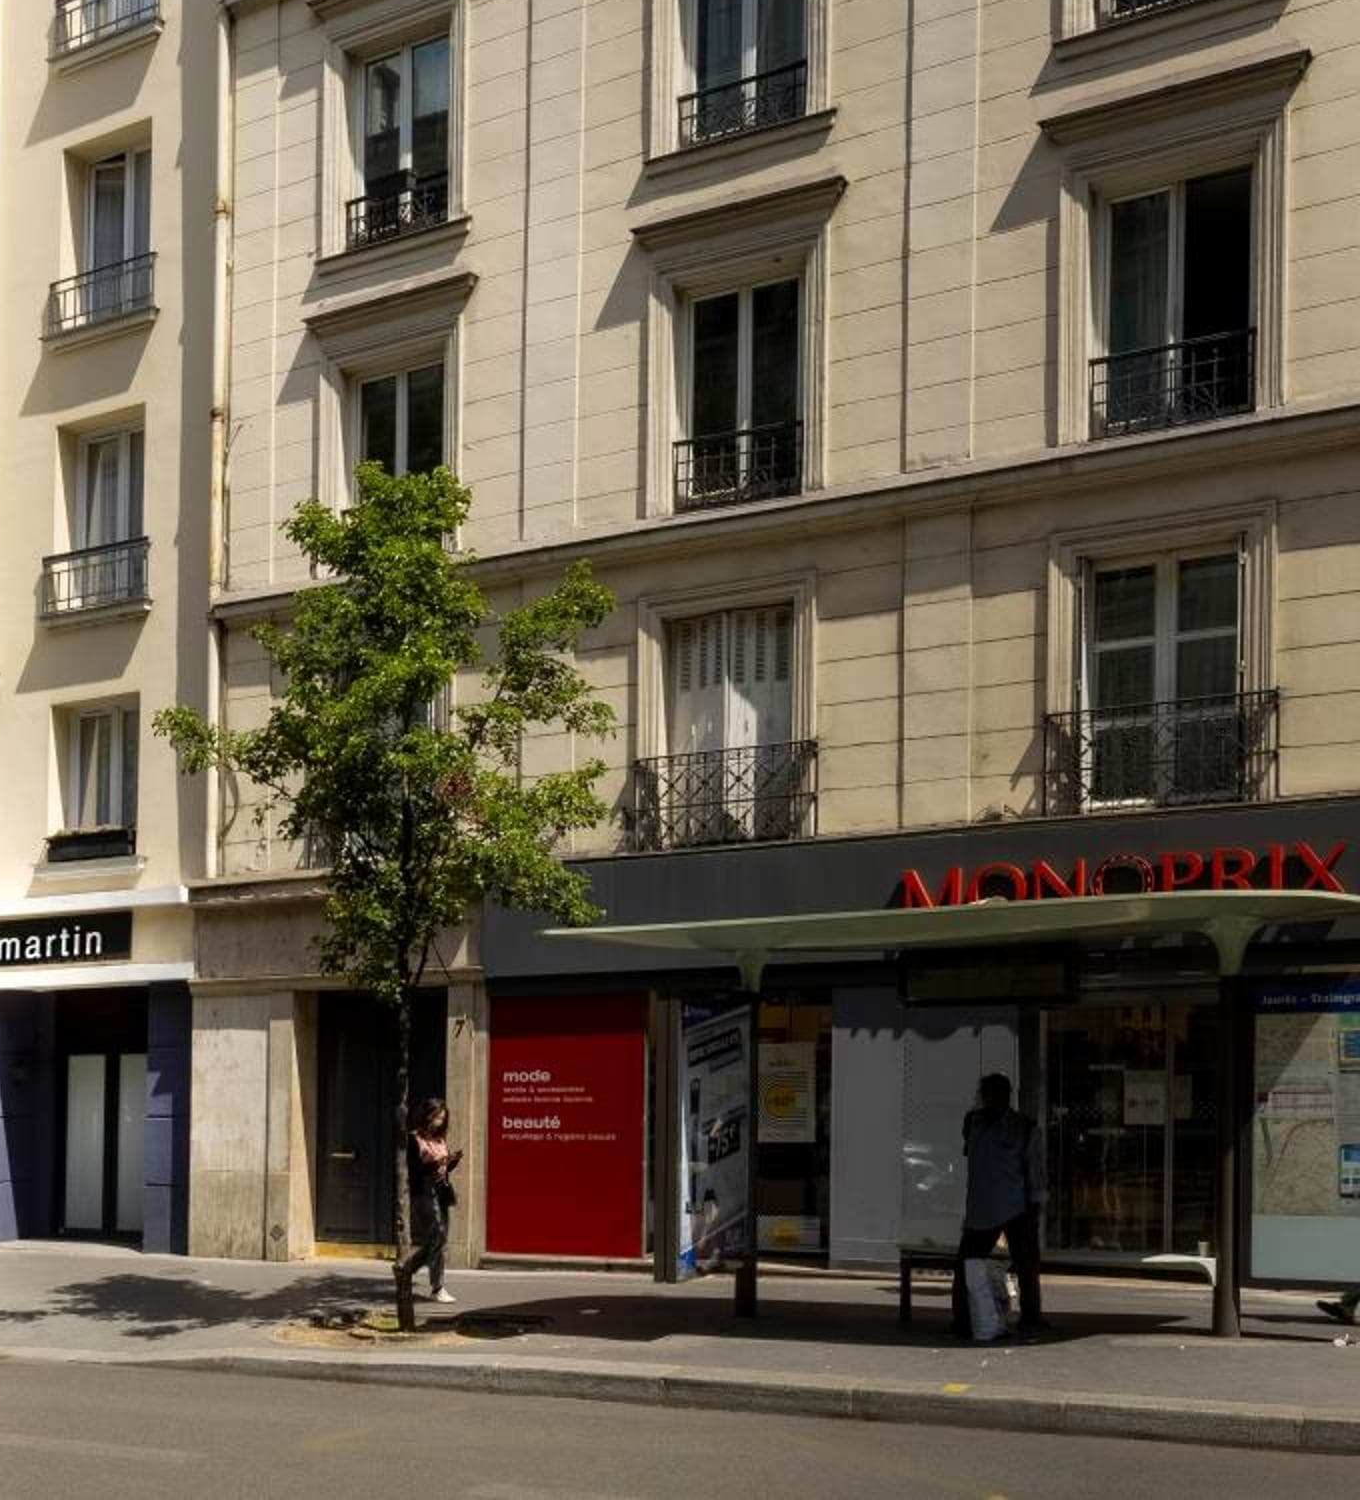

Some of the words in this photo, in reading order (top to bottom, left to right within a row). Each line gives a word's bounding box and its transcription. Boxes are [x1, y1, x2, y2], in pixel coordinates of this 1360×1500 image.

[901, 839, 1346, 908] MONOPRIX
[502, 1069, 551, 1083] mode
[502, 1115, 561, 1129] beauté
